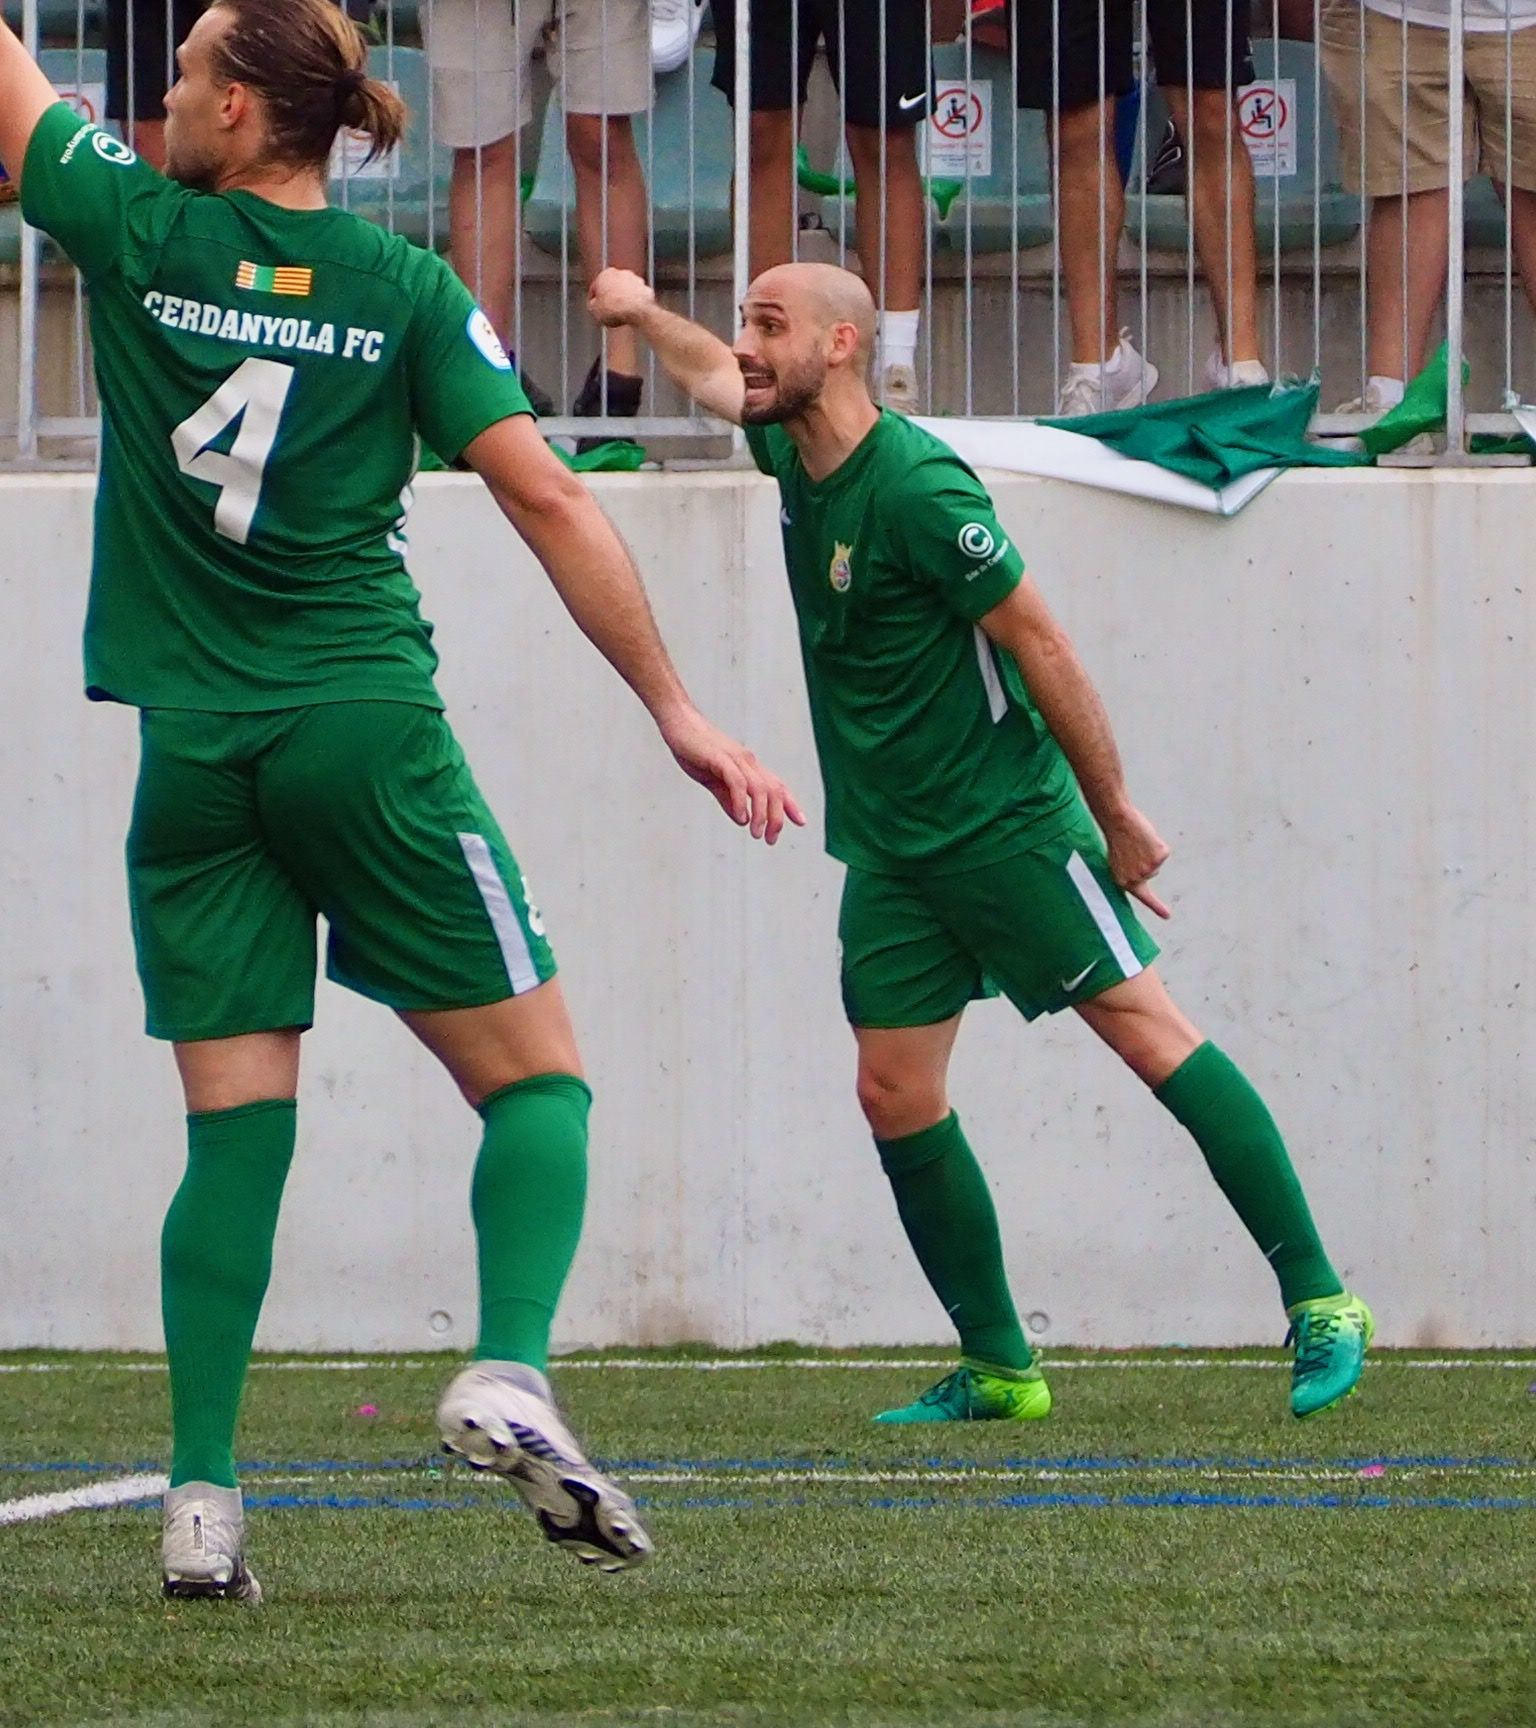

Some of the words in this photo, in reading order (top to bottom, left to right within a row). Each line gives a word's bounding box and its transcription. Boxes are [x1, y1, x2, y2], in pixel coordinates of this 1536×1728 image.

[142, 290, 335, 354] CERDANYOLA
[342, 328, 384, 362] FC
[170, 357, 295, 544] 4
